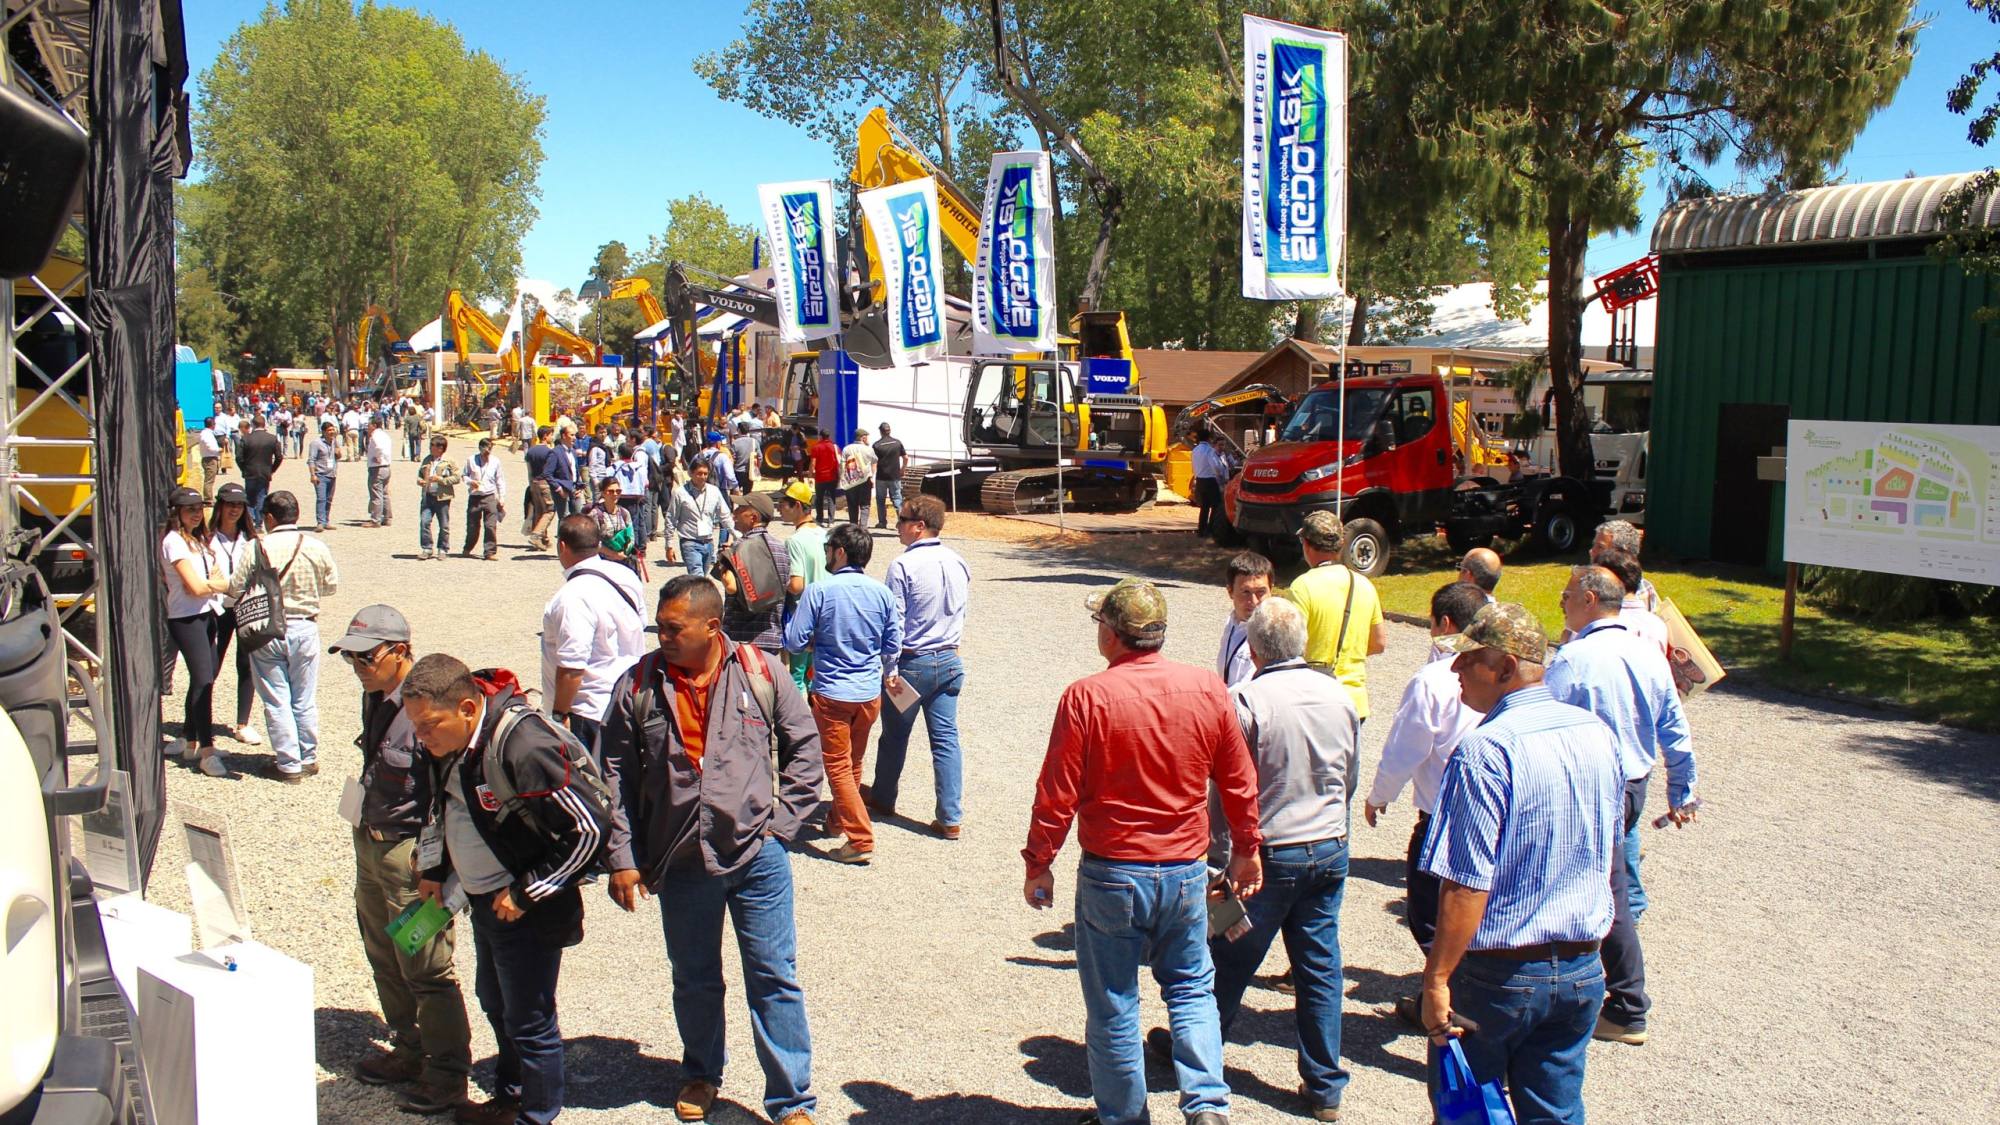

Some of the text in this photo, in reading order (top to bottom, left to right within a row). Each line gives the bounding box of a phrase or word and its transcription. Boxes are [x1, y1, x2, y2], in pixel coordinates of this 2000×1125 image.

[708, 294, 756, 313] VOLVO
[1253, 469, 1279, 478] IVECO
[243, 600, 269, 615] YEARS
